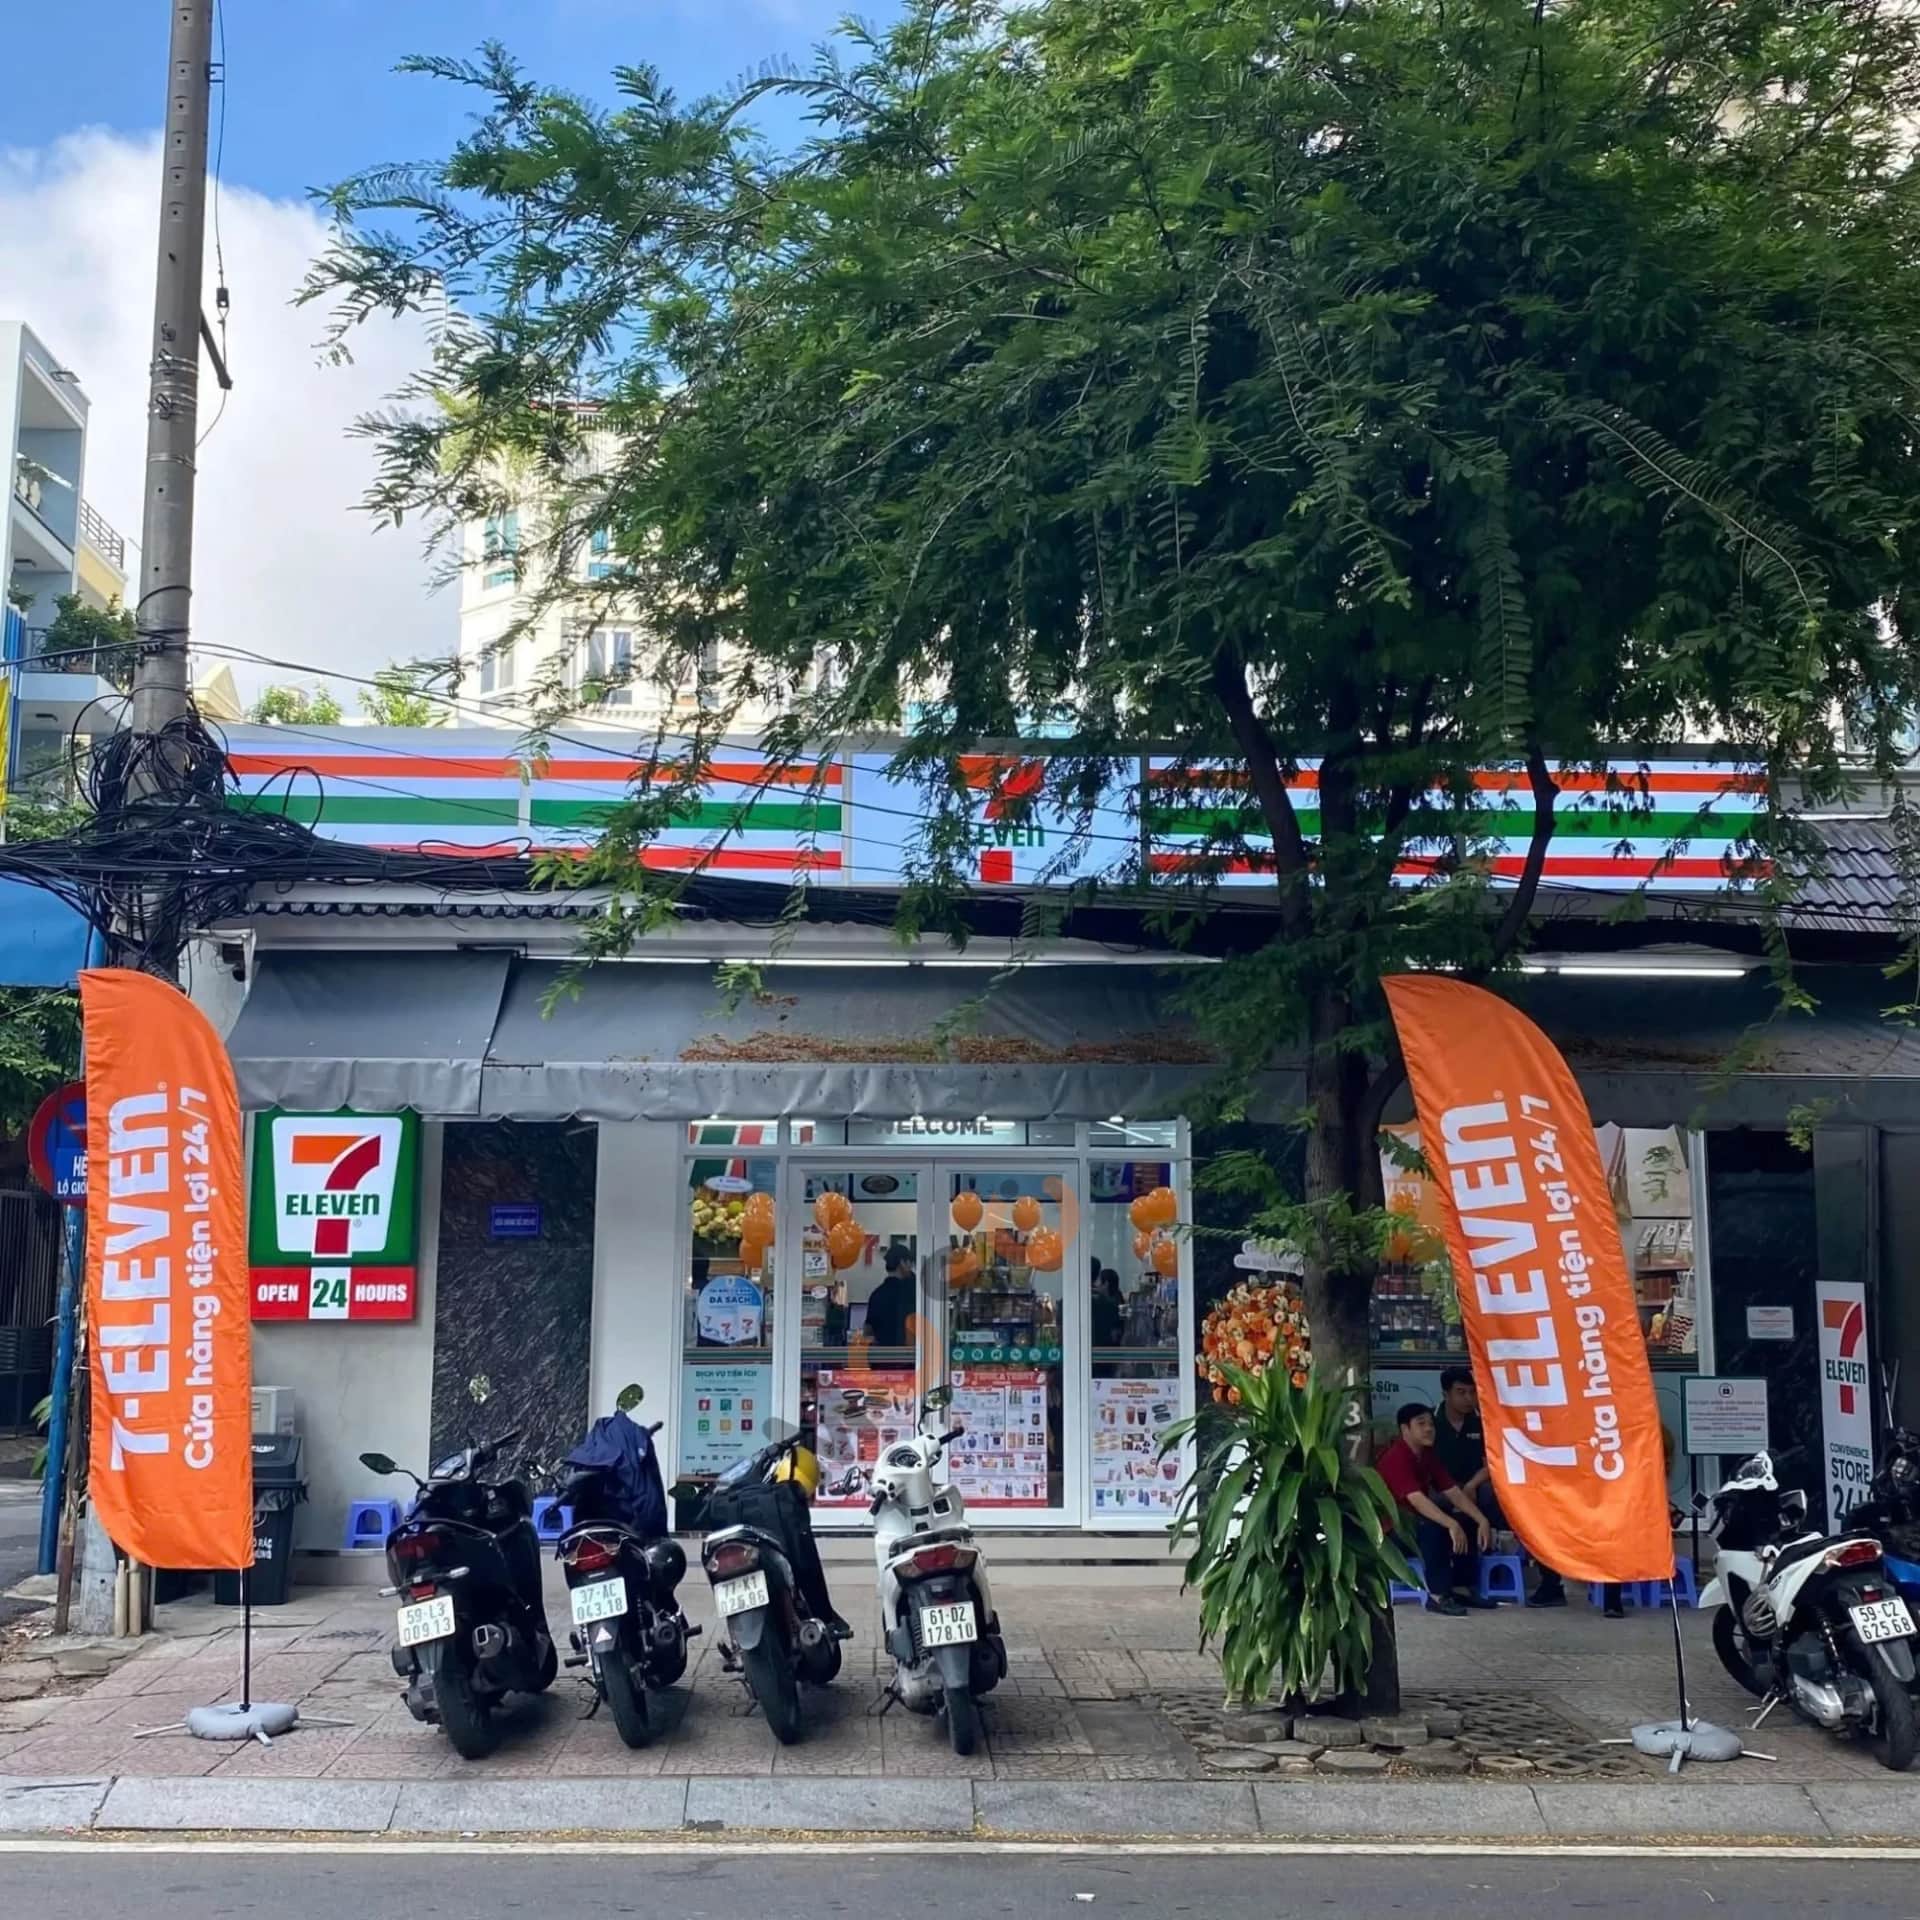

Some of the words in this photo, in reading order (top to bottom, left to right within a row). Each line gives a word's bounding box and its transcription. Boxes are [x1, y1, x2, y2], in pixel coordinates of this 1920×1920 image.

[177, 1086, 212, 1165] 24/7
[1519, 1093, 1565, 1175] 24/7
[183, 1172, 219, 1213] lợi
[1539, 1180, 1580, 1222] lợi
[185, 1220, 219, 1288] tiện
[1557, 1229, 1595, 1298] tiện
[257, 1284, 299, 1302] OPEN
[312, 1278, 348, 1309] 24
[355, 1284, 407, 1302] HOURS
[184, 1295, 221, 1386] hàng
[1574, 1305, 1613, 1398] hàng
[183, 1394, 214, 1470] Cửa
[1589, 1404, 1625, 1481] Cửa
[1830, 1442, 1870, 1460] CONVENIENCE
[1832, 1457, 1872, 1486] STORE
